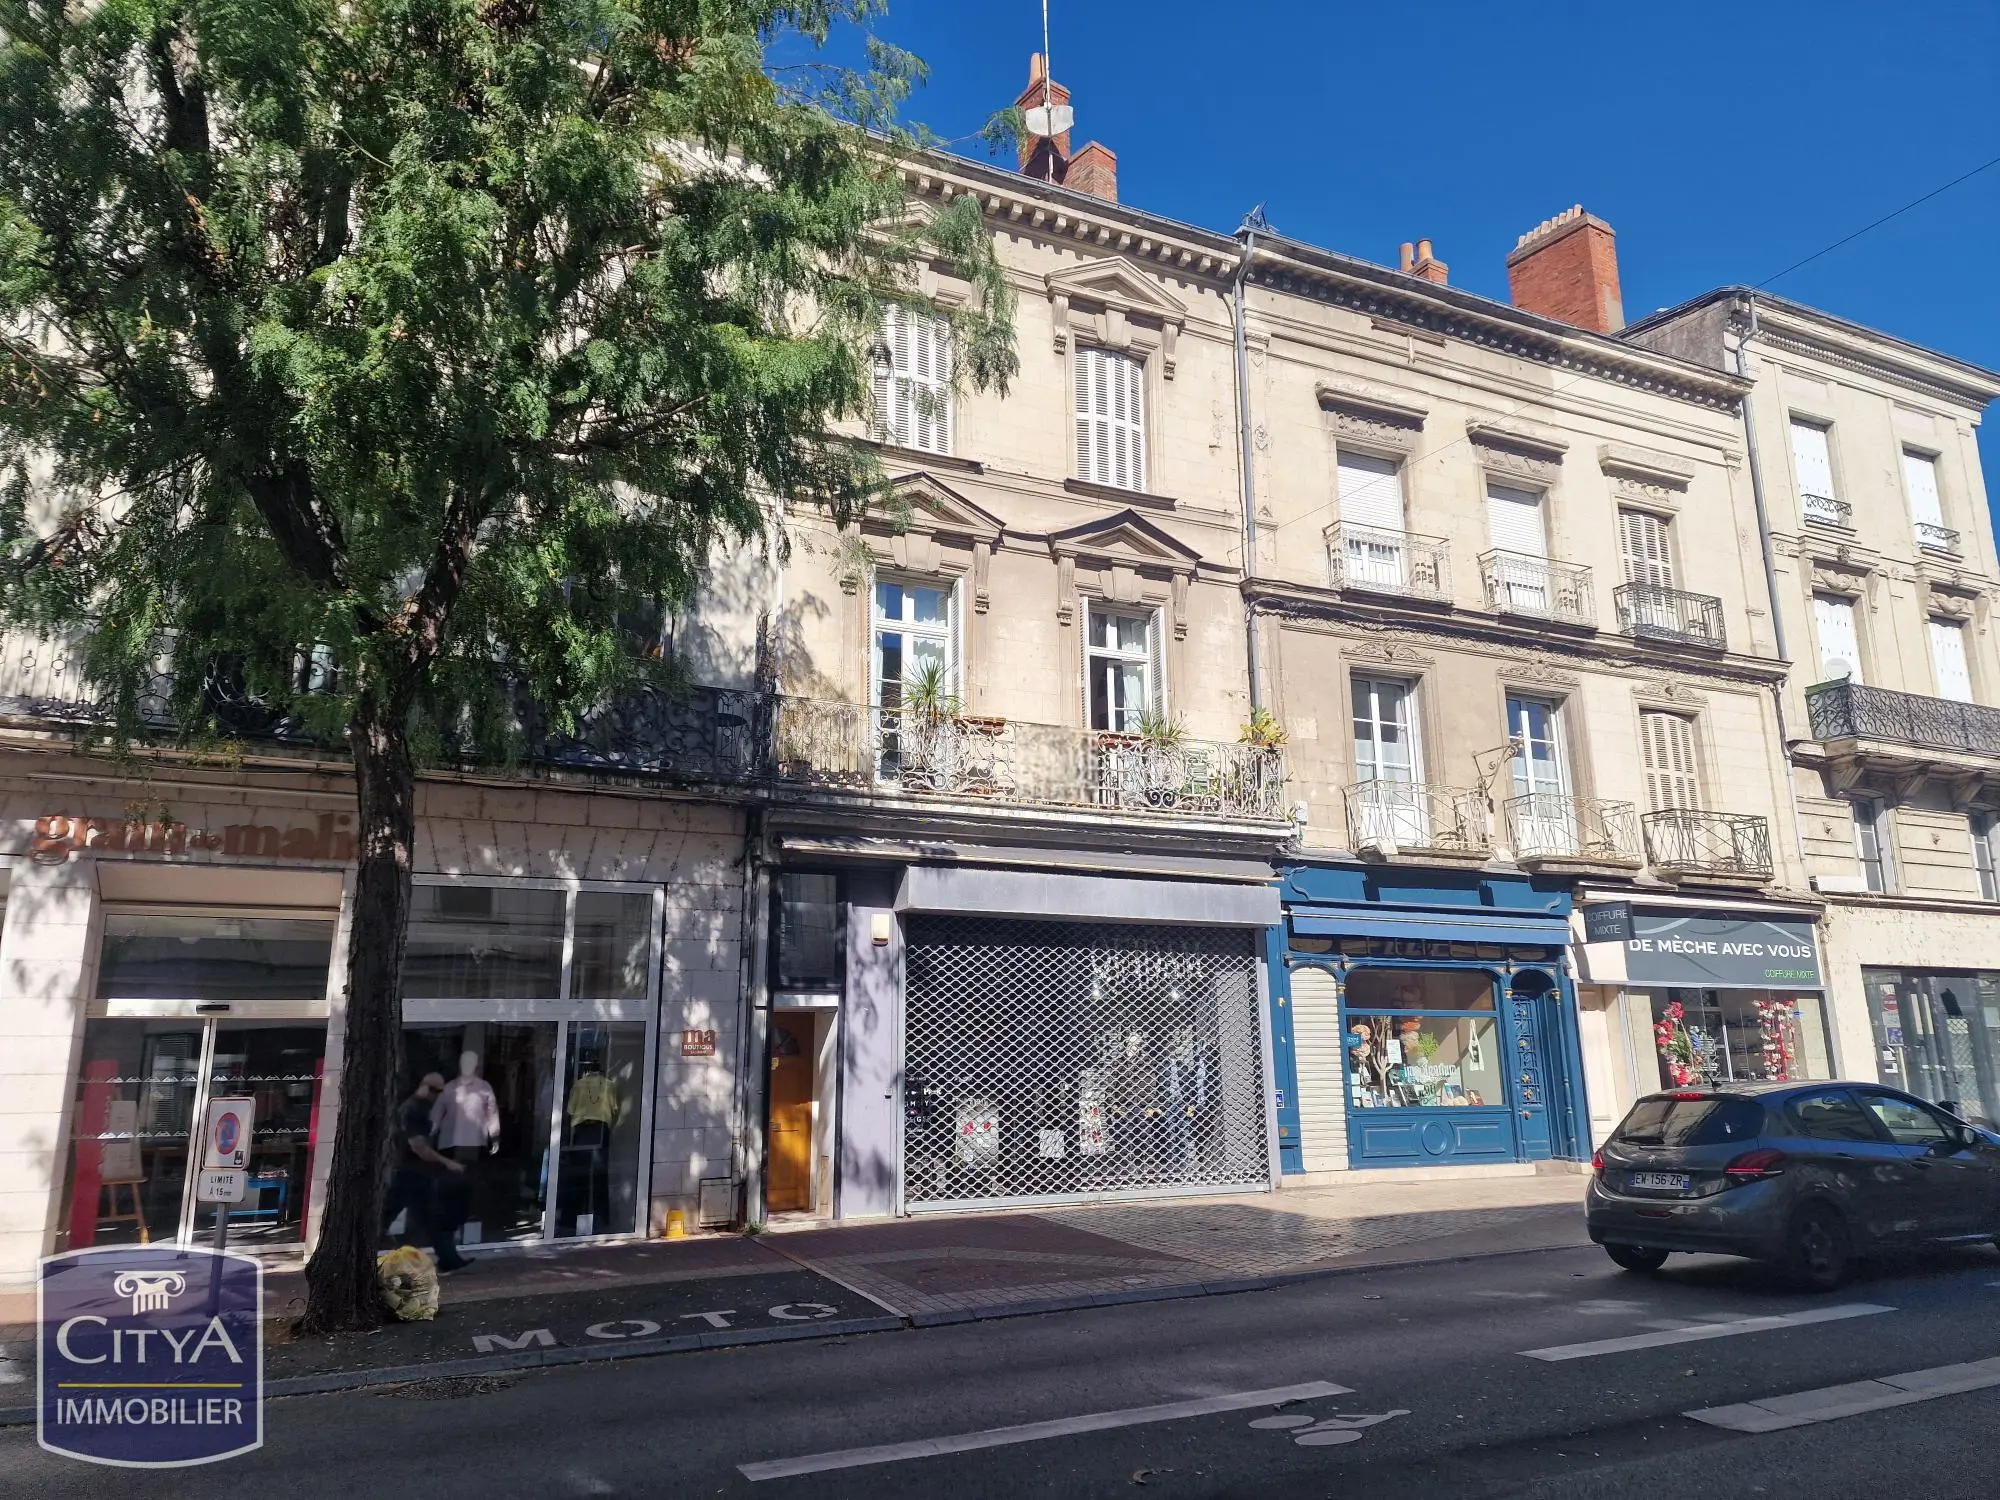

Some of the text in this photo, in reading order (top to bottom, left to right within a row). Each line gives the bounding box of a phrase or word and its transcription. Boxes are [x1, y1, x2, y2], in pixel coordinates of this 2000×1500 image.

[224, 813, 359, 861] mali
[1586, 909, 1628, 921] COIFFURE
[1594, 924, 1622, 936] MIXTE
[1629, 934, 1812, 959] DE MÈCHE AVEC VOUS
[1765, 969, 1794, 979] COIFFURE
[210, 1174, 234, 1185] LIMITÉ
[472, 1303, 839, 1352] MOTO
